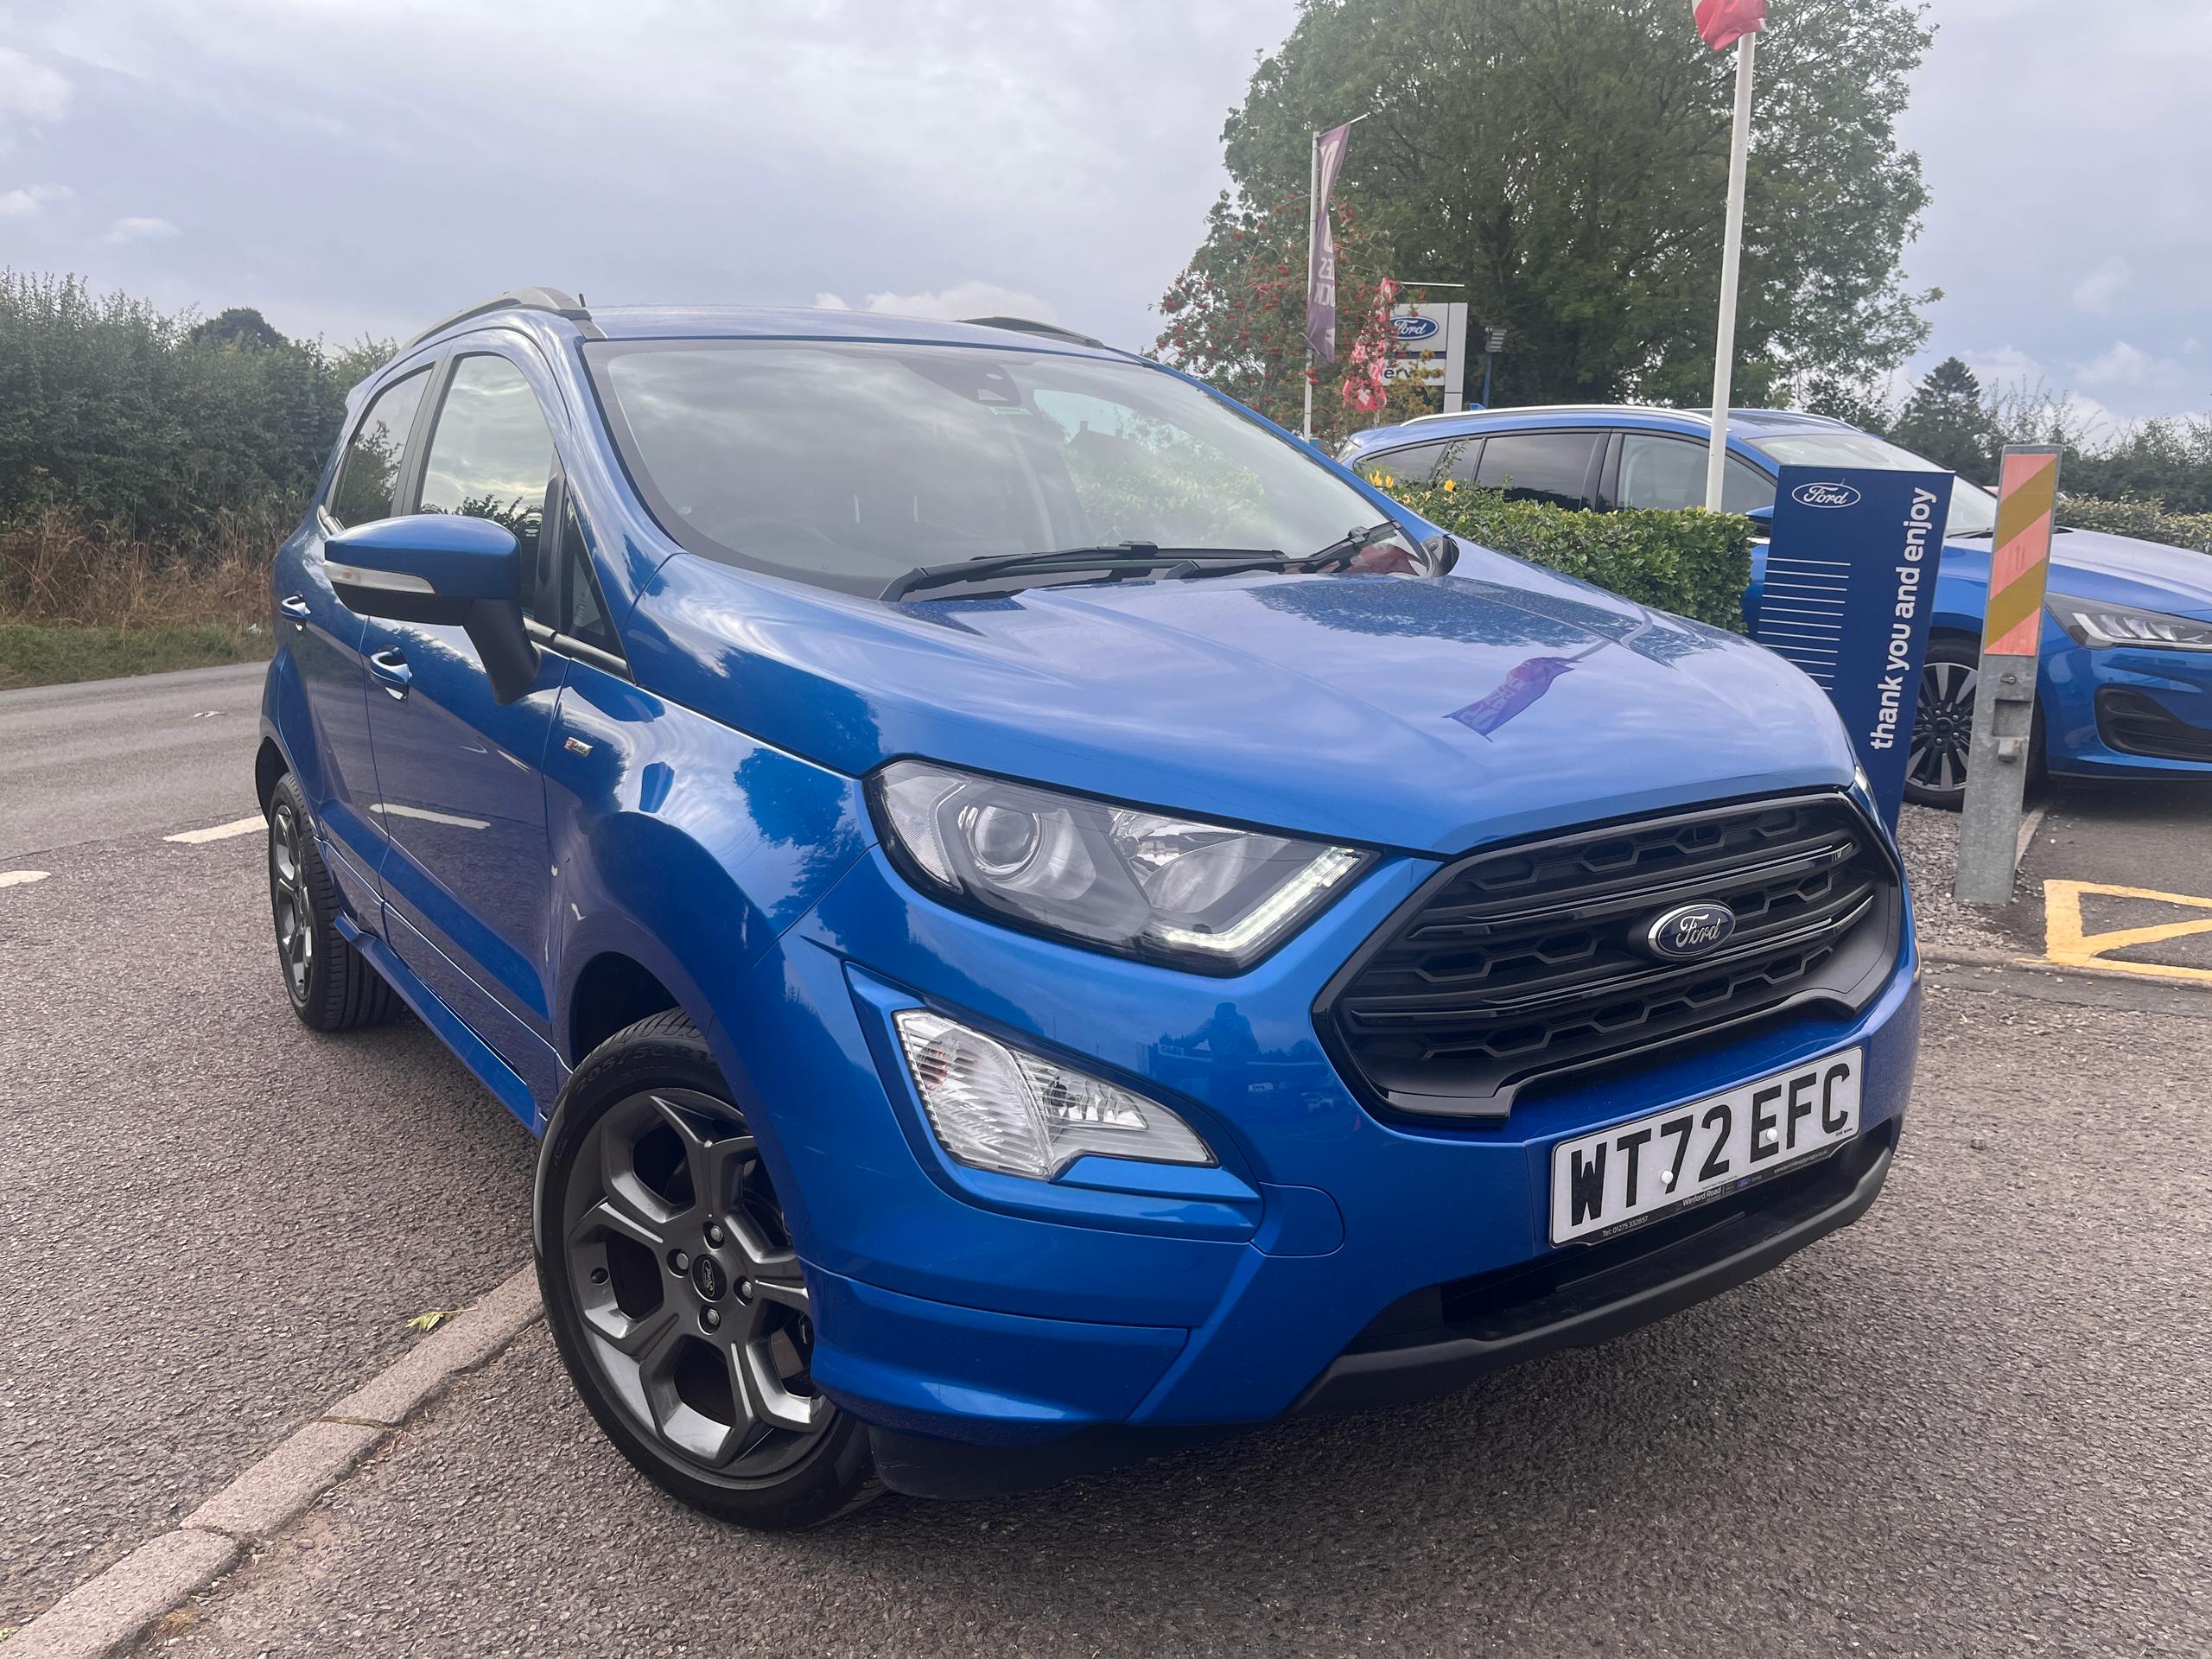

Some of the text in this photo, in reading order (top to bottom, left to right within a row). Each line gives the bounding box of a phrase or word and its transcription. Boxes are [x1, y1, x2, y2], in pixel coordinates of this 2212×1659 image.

[1393, 319, 1427, 335] Ford
[1802, 486, 1849, 505] Ford
[1870, 486, 1937, 750] thank you and enjoy
[1675, 912, 1722, 949] Ford
[1569, 1062, 1851, 1227] WT72 EFC
[1682, 1190, 1707, 1207] Winford
[1706, 1185, 1722, 1198] Road
